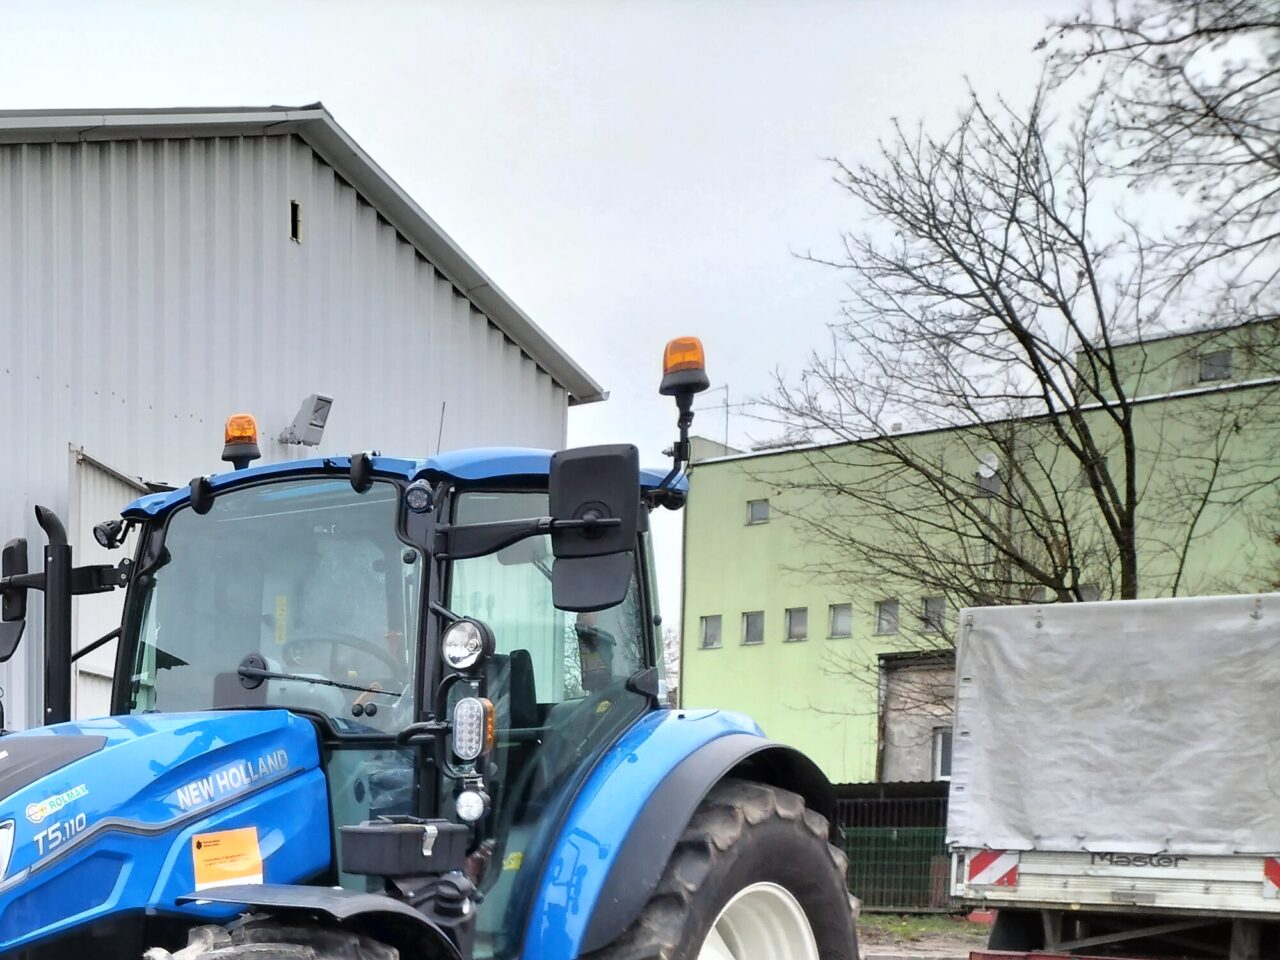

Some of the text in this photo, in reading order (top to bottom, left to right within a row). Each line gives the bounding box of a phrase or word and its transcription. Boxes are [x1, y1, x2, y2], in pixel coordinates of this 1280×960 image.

[176, 749, 289, 810] NEW HOLLAND
[33, 812, 86, 855] T5.110
[1090, 852, 1189, 868] Master
